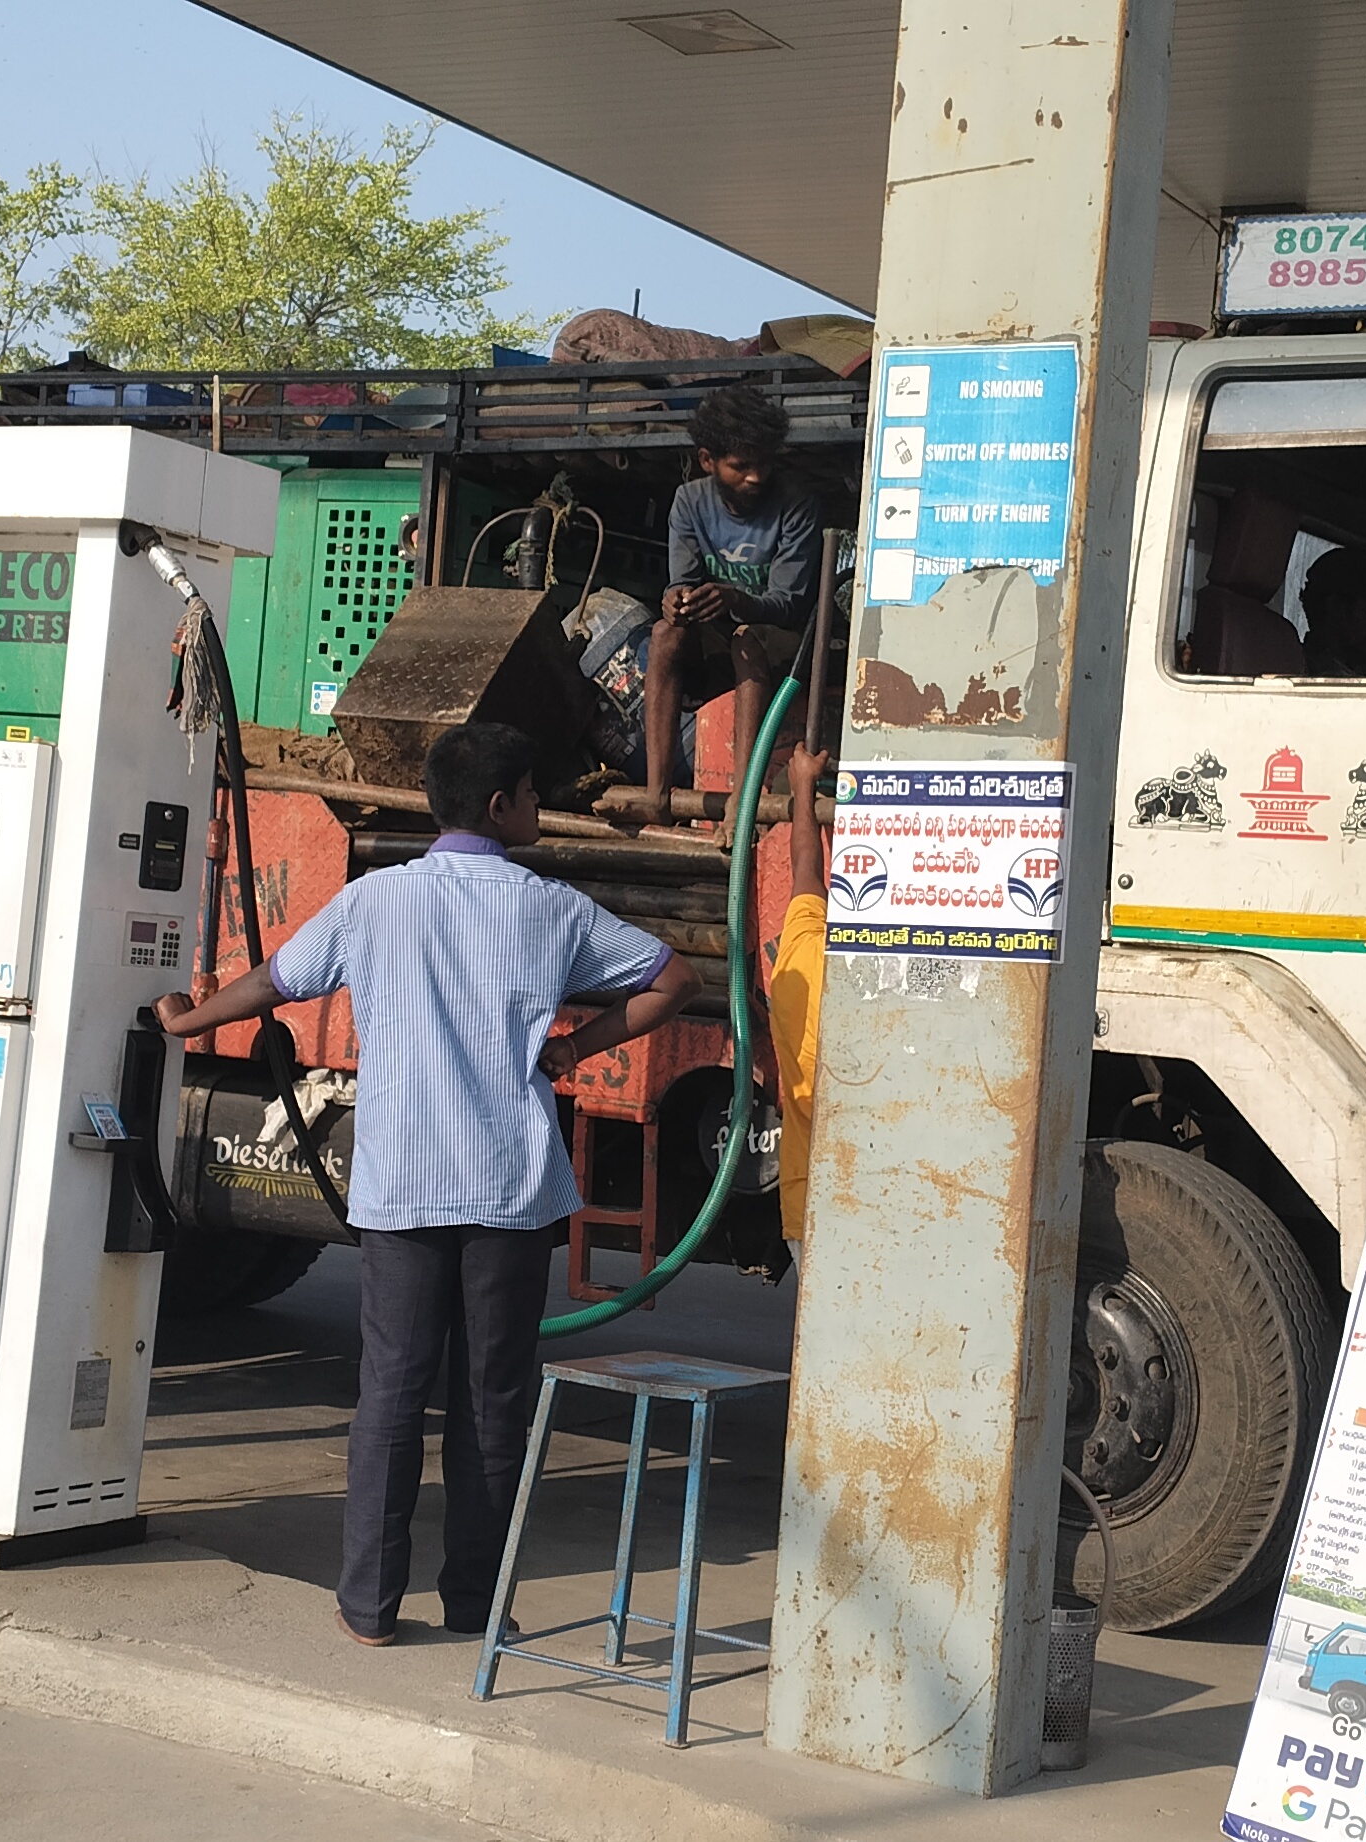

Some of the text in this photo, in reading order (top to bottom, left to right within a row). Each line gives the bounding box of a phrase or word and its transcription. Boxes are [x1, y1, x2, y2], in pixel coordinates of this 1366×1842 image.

[959, 379, 1044, 399] NO SMOKING
[925, 442, 1069, 462] SWITCH OFF MOBILES
[934, 504, 1051, 523] TURN OFF ENGINE
[914, 557, 967, 576] ENSURE
[861, 774, 911, 797] మనం
[928, 775, 966, 798] మన
[849, 812, 873, 837] మన
[842, 854, 877, 874] HP
[911, 846, 981, 874] దయచేసి
[1023, 857, 1060, 879] HP
[890, 883, 1005, 909] సహకరించండి
[912, 930, 945, 947] మన
[948, 931, 992, 949] జీవన
[213, 1133, 288, 1172] Diesel
[711, 1122, 783, 1166] fter
[1332, 1715, 1363, 1741] Go
[1281, 1784, 1317, 1822] G
[1240, 1822, 1271, 1842] Note
